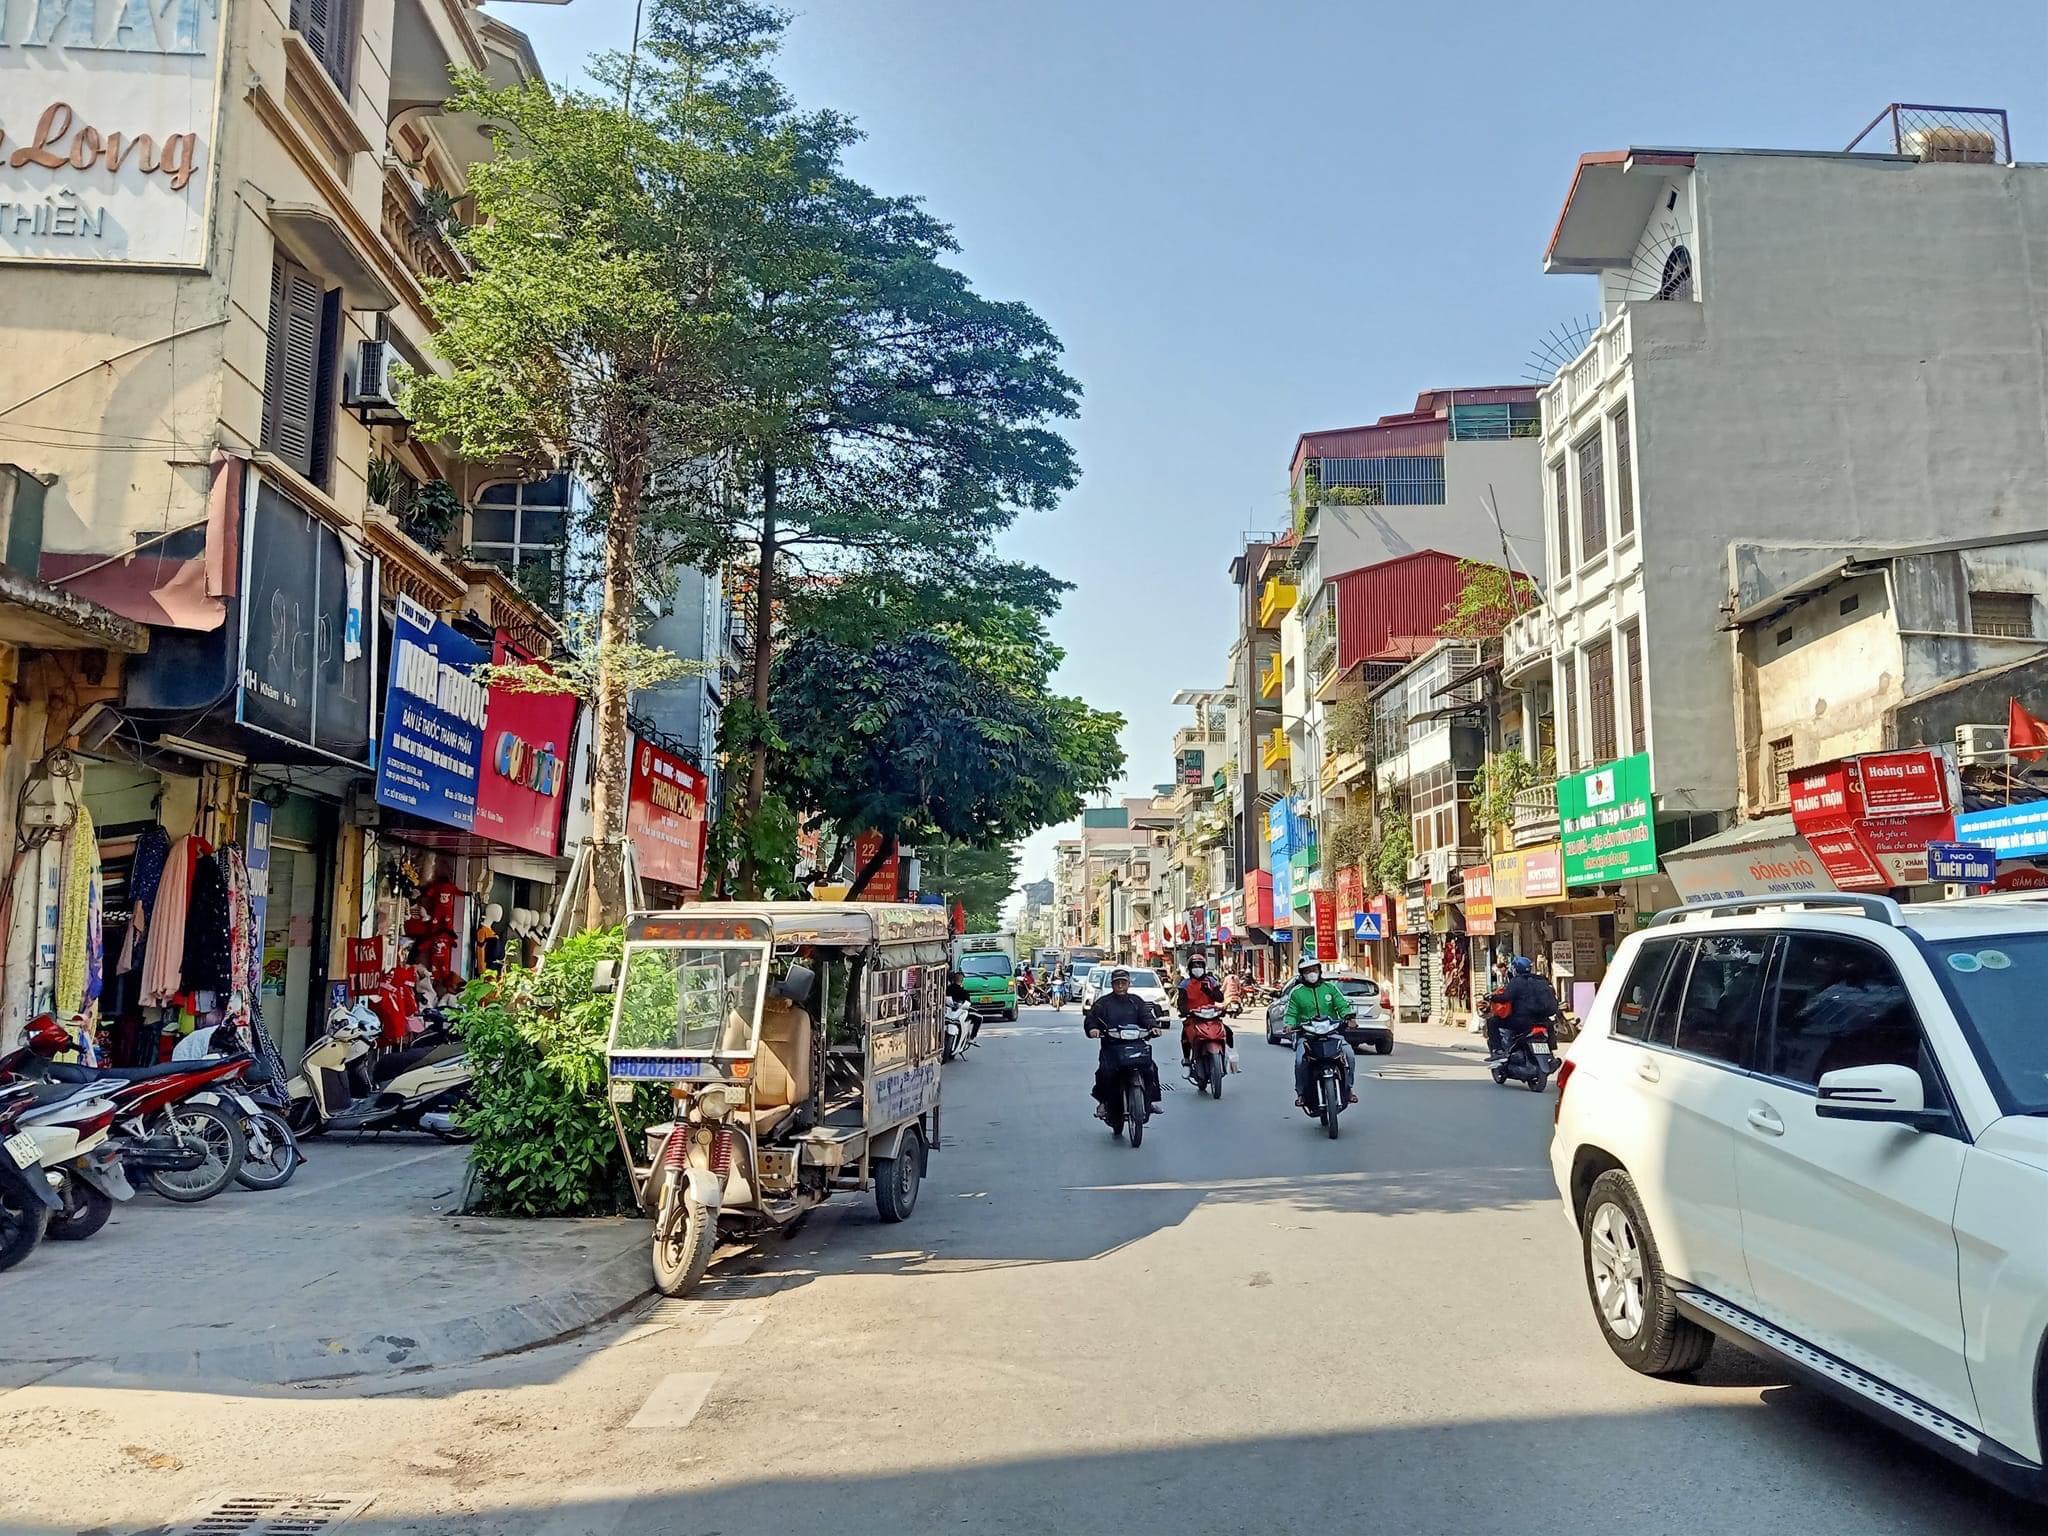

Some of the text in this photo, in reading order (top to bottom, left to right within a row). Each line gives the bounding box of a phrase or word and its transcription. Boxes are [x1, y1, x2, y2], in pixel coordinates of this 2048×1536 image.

[11, 102, 199, 190] Long
[400, 602, 414, 618] THU
[396, 639, 438, 705] NHÀ
[1869, 764, 1903, 778] Hoàng
[1906, 764, 1925, 774] Lan
[651, 779, 678, 811] THANH
[1936, 861, 1988, 877] THIÊN HÙNG
[1768, 882, 1791, 892] MINH
